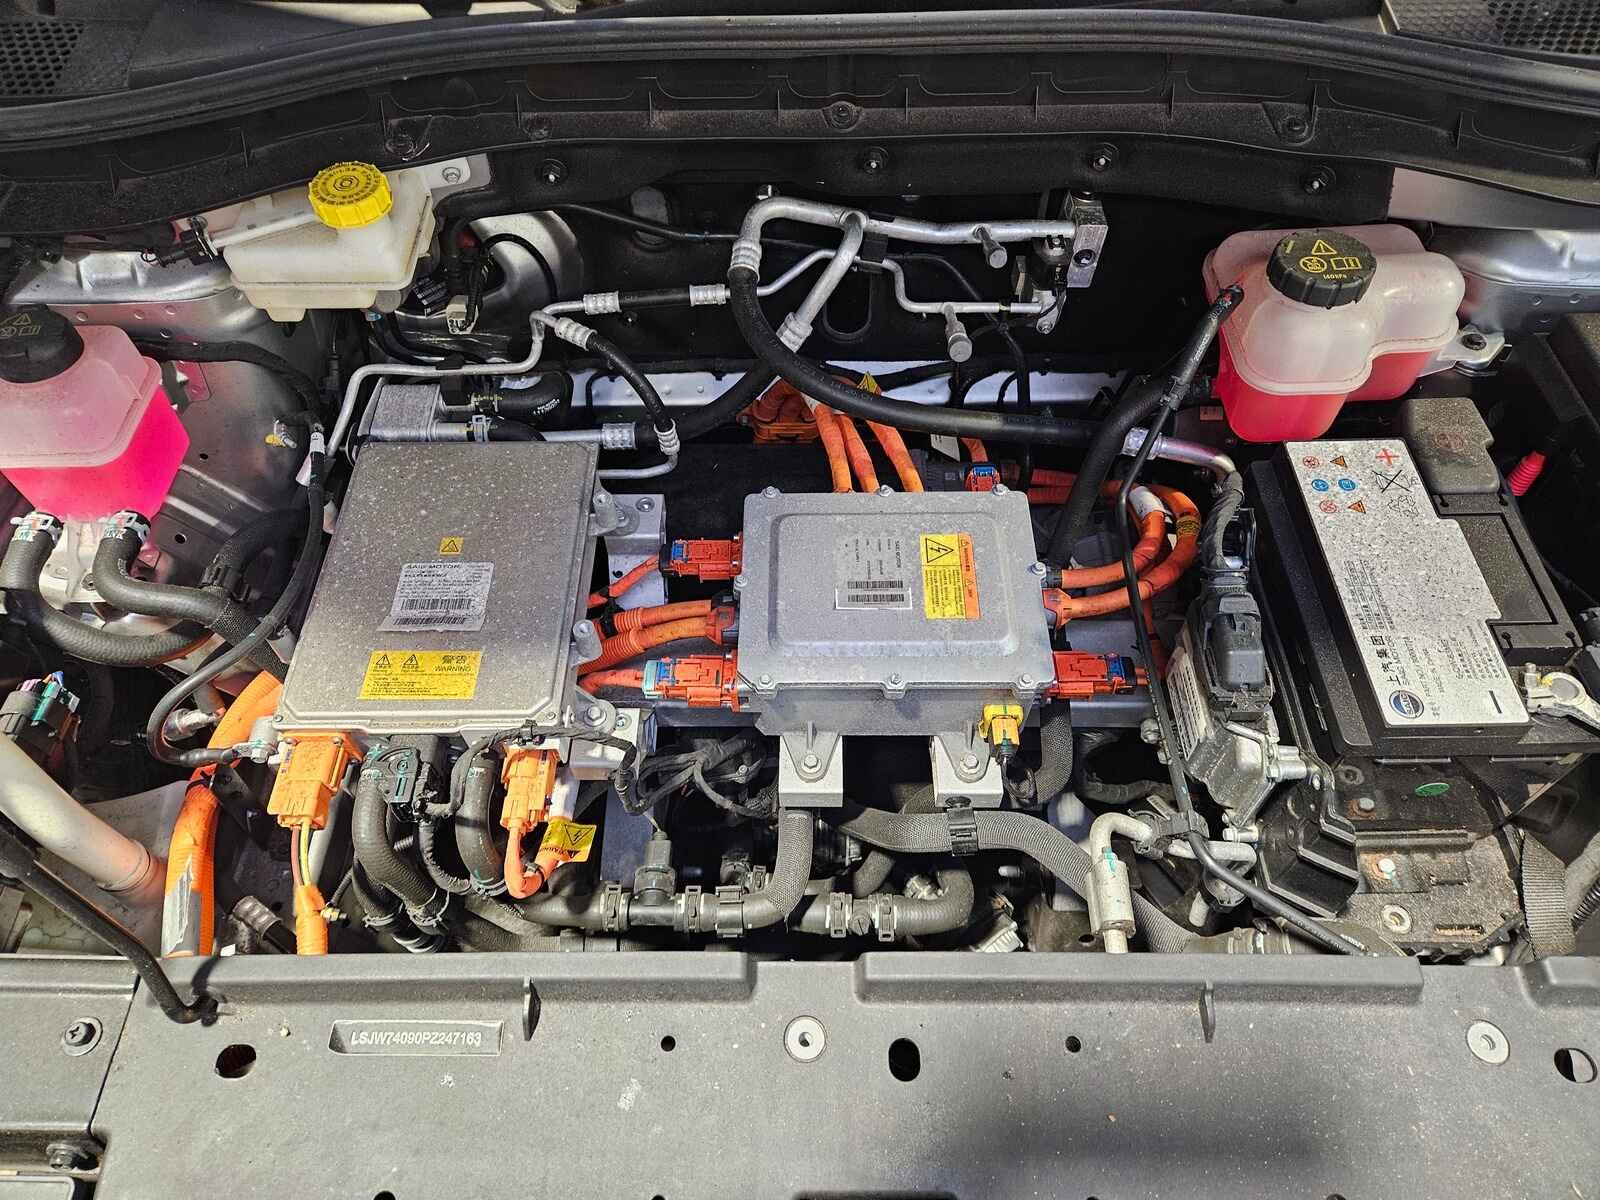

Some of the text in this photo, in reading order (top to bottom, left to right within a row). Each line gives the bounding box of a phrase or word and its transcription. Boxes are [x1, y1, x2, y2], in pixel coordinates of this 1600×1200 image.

[1369, 635, 1400, 685] 上汽集团
[1384, 634, 1401, 663] MOTOR
[1400, 693, 1414, 714] SAIC
[351, 1031, 482, 1047] LSJW74090PZ247163
